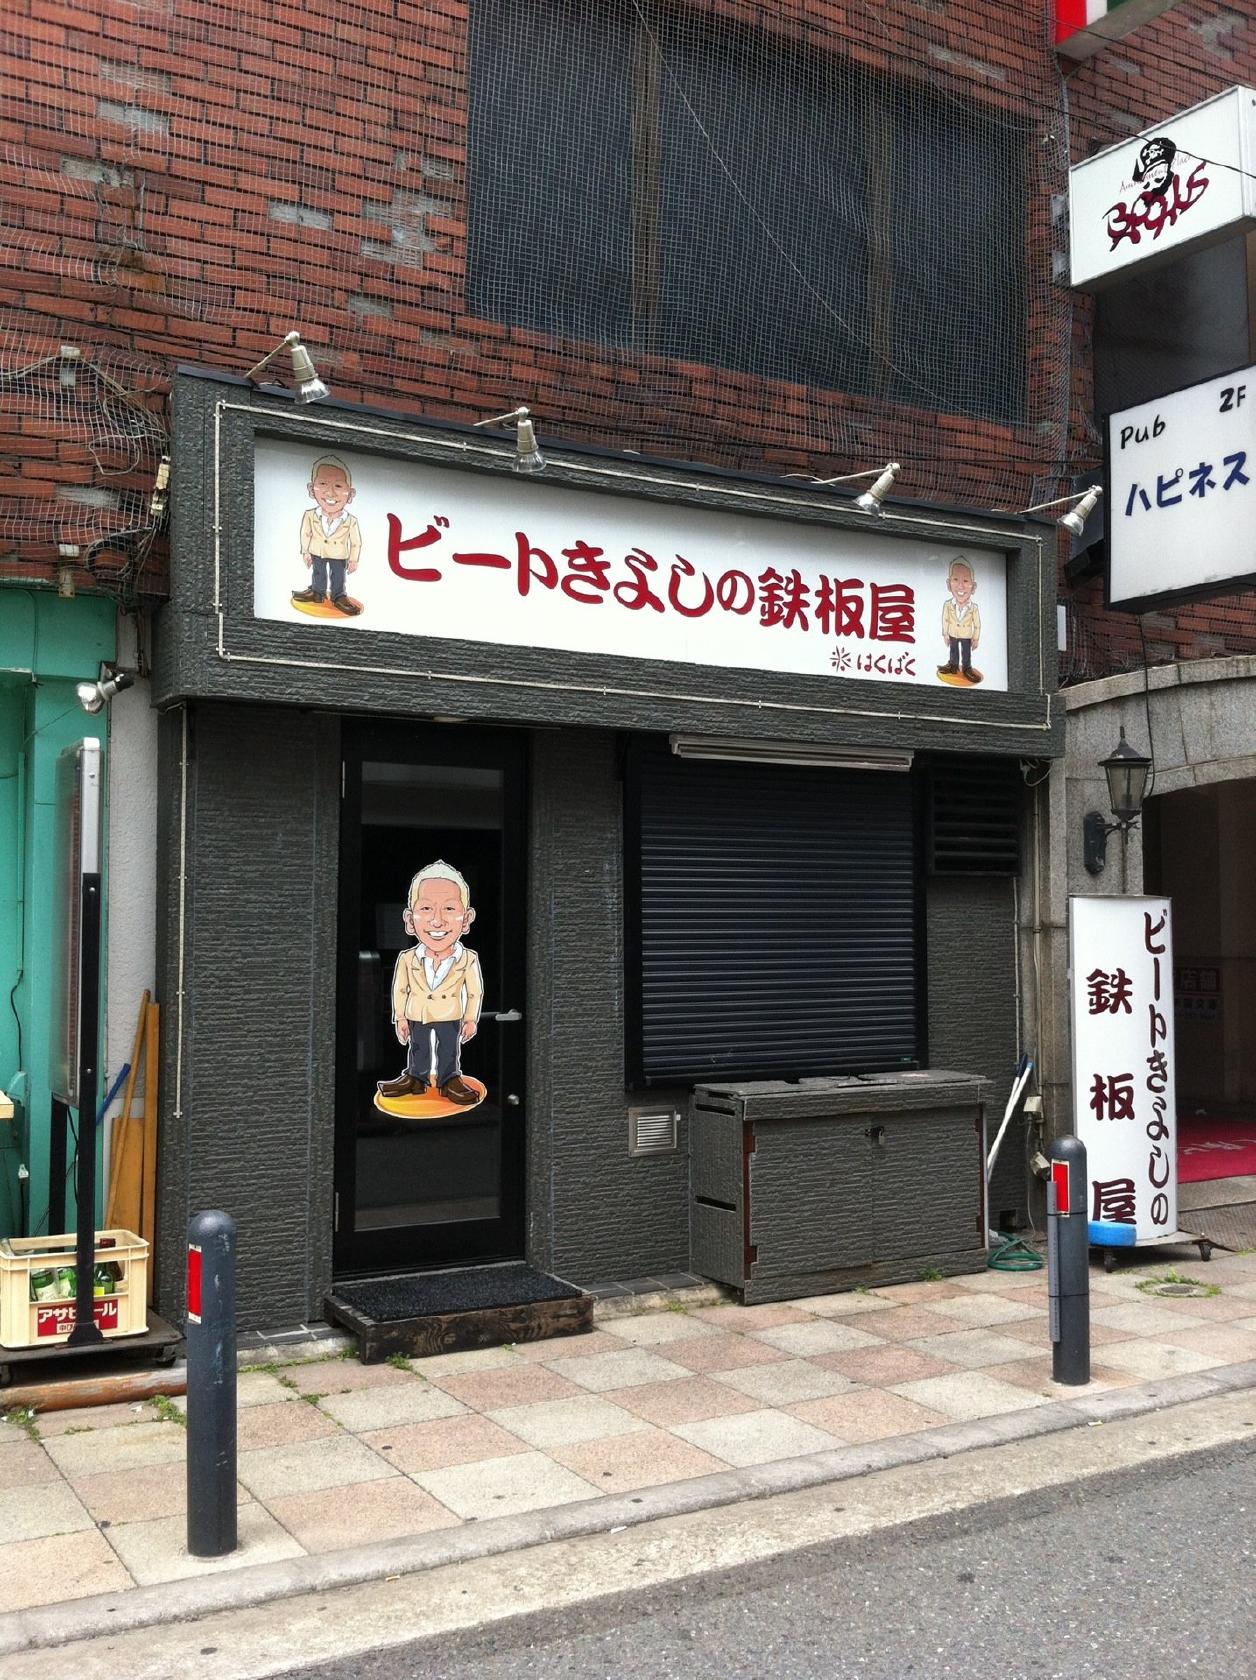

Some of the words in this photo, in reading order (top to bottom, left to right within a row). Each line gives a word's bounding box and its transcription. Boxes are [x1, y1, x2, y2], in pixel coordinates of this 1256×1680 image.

[1219, 385, 1246, 412] 2F
[1120, 414, 1166, 449] Pub
[1125, 451, 1250, 516] ハピネス
[386, 512, 916, 643] ビートきよしの鉄板屋
[857, 652, 916, 676] はくばく
[1143, 908, 1170, 1225] ビートきよしの
[1086, 967, 1137, 1225] 鉄板屋
[38, 1302, 117, 1324] アサヒール
